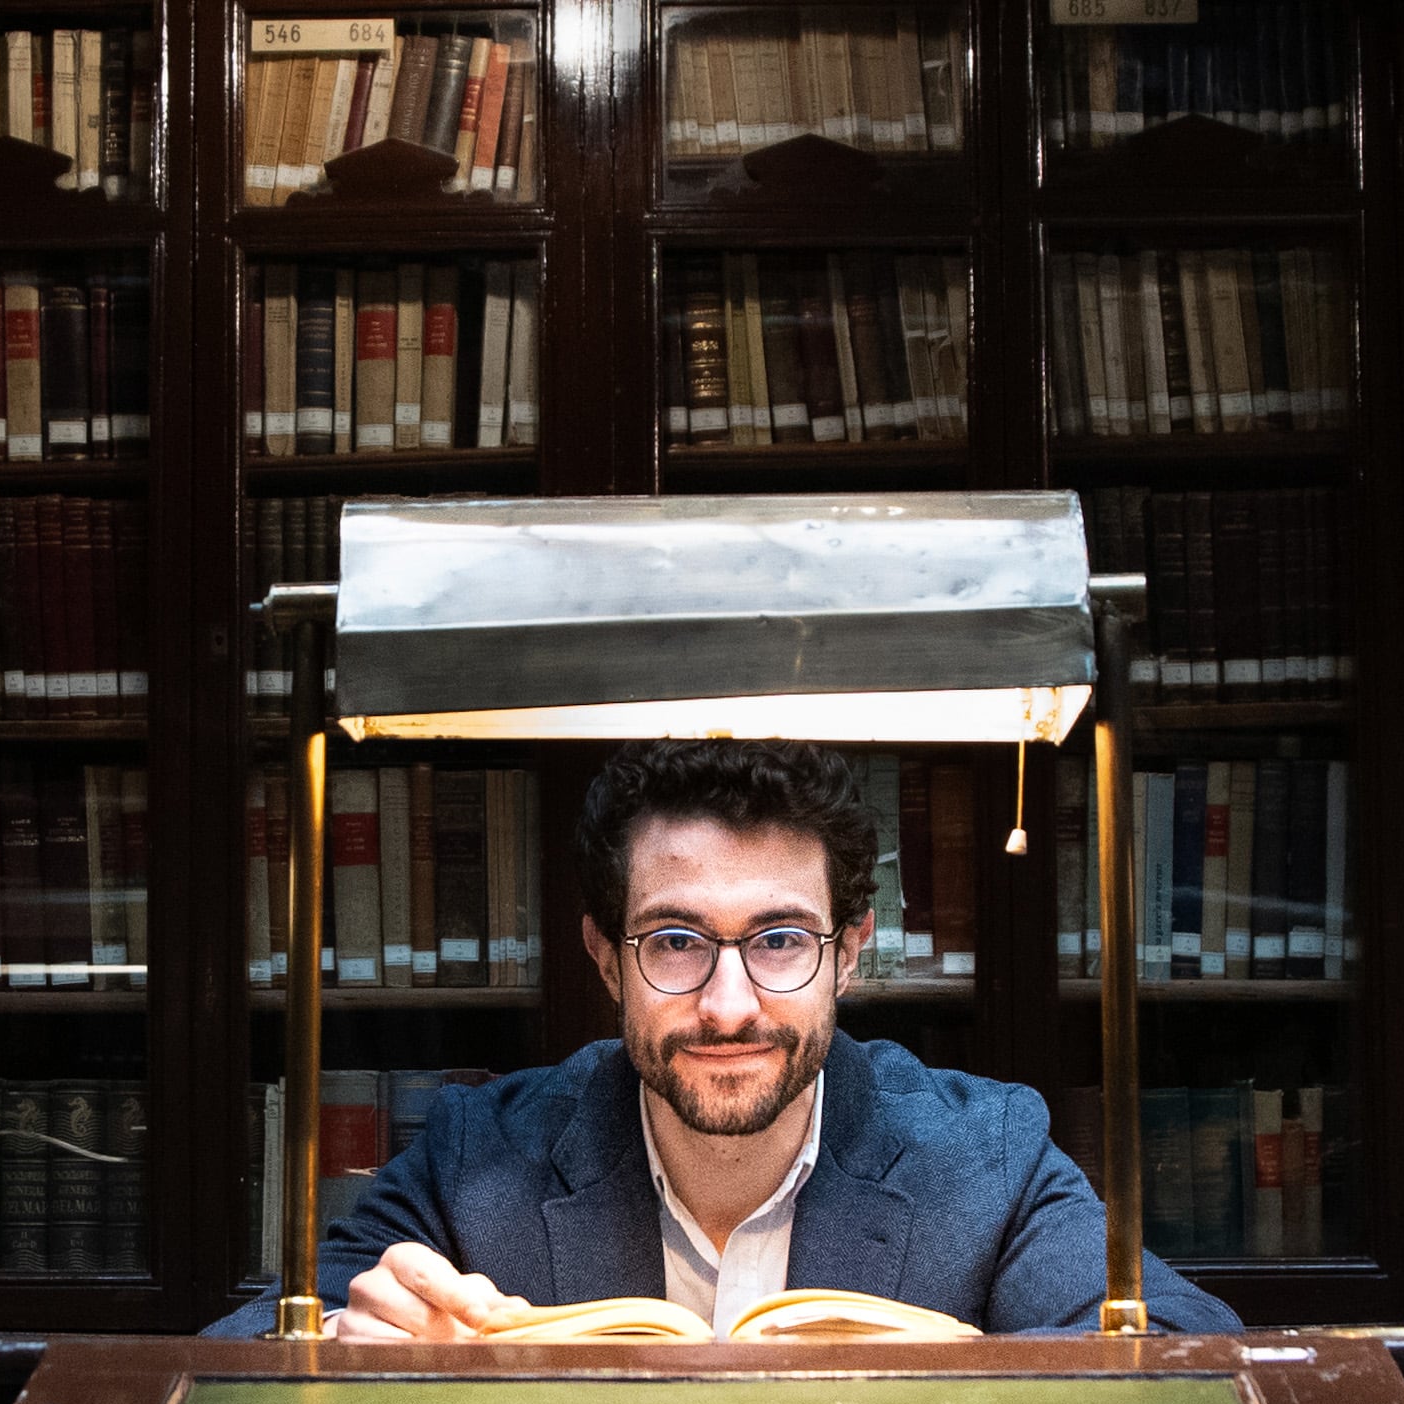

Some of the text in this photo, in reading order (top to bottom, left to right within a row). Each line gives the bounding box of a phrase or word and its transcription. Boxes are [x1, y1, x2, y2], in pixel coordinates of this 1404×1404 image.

[1069, 0, 1106, 17] 685
[264, 23, 386, 44] 546 684
